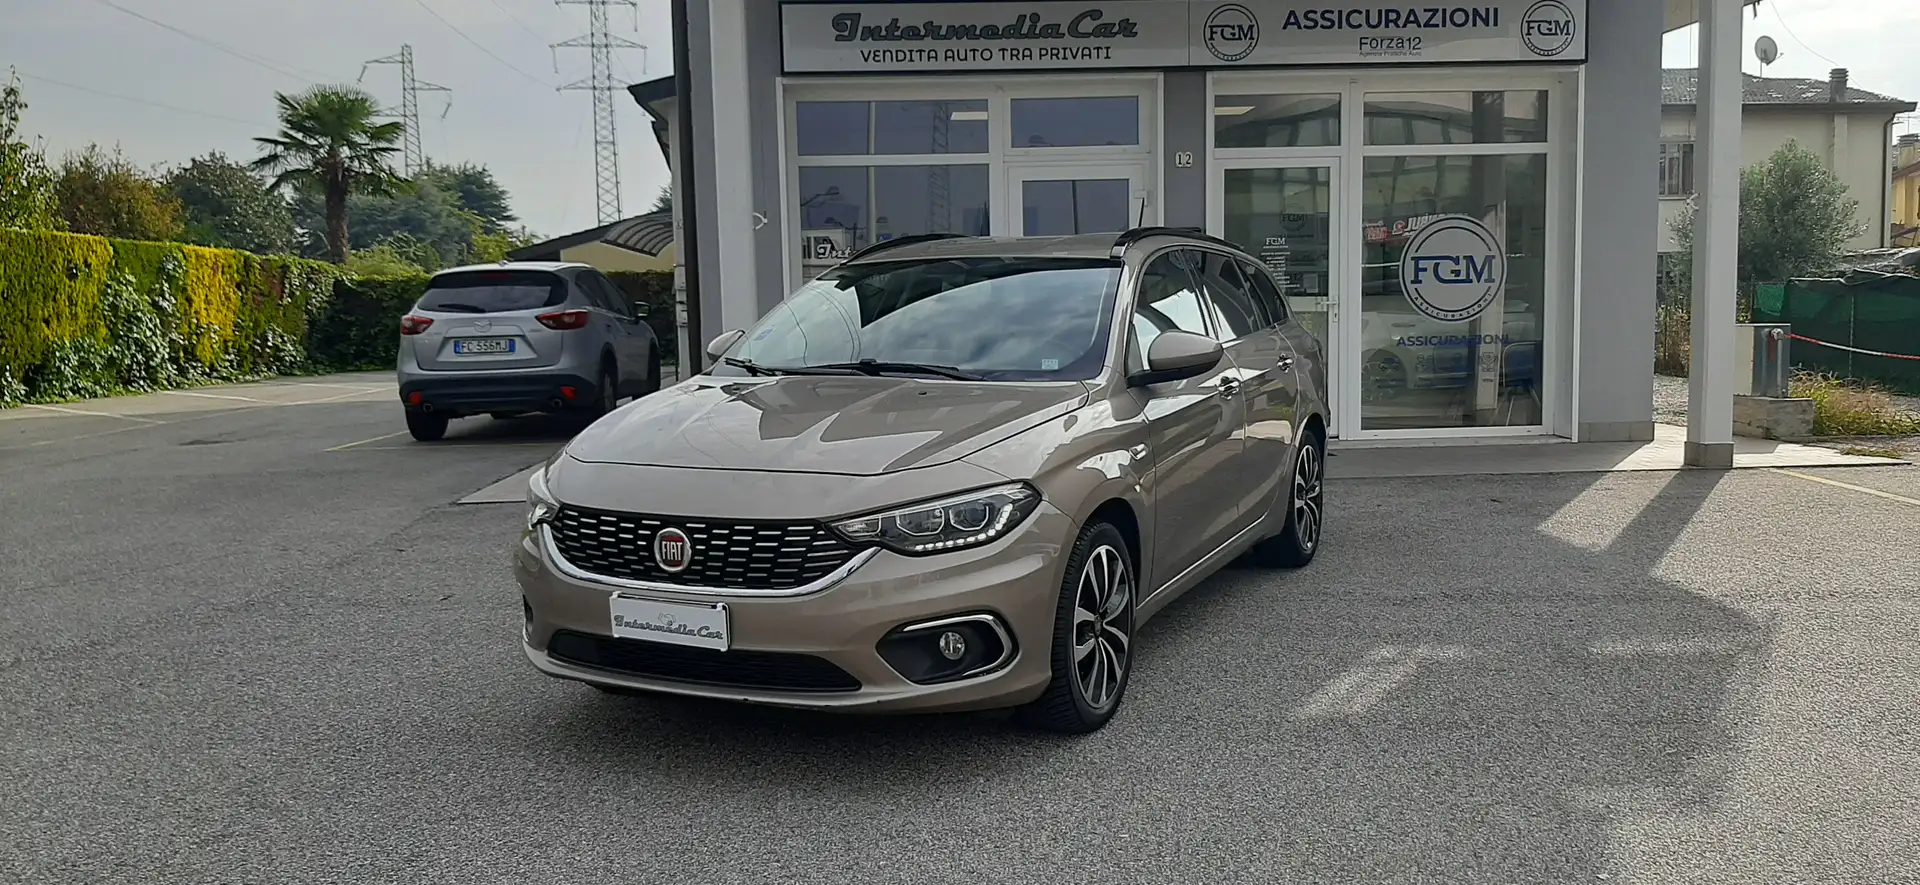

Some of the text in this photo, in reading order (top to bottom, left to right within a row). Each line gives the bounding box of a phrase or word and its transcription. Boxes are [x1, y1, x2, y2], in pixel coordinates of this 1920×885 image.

[832, 9, 1138, 42] Intermedia Car
[1282, 7, 1499, 30] ASSICURAZIONI
[1208, 24, 1255, 41] FGM
[1525, 19, 1571, 36] FGM
[1359, 36, 1422, 50] Forza12
[860, 46, 1112, 62] VENDITA AUTO TRA PRIVATI
[1177, 152, 1192, 166] 12
[1265, 237, 1286, 245] FGM
[816, 243, 857, 259] Int
[1410, 254, 1496, 285] FGM
[1413, 292, 1494, 320] ASSICURAZIONI
[461, 341, 474, 352] FC
[661, 541, 683, 561] FIAT
[613, 614, 724, 640] Intermedia Car
